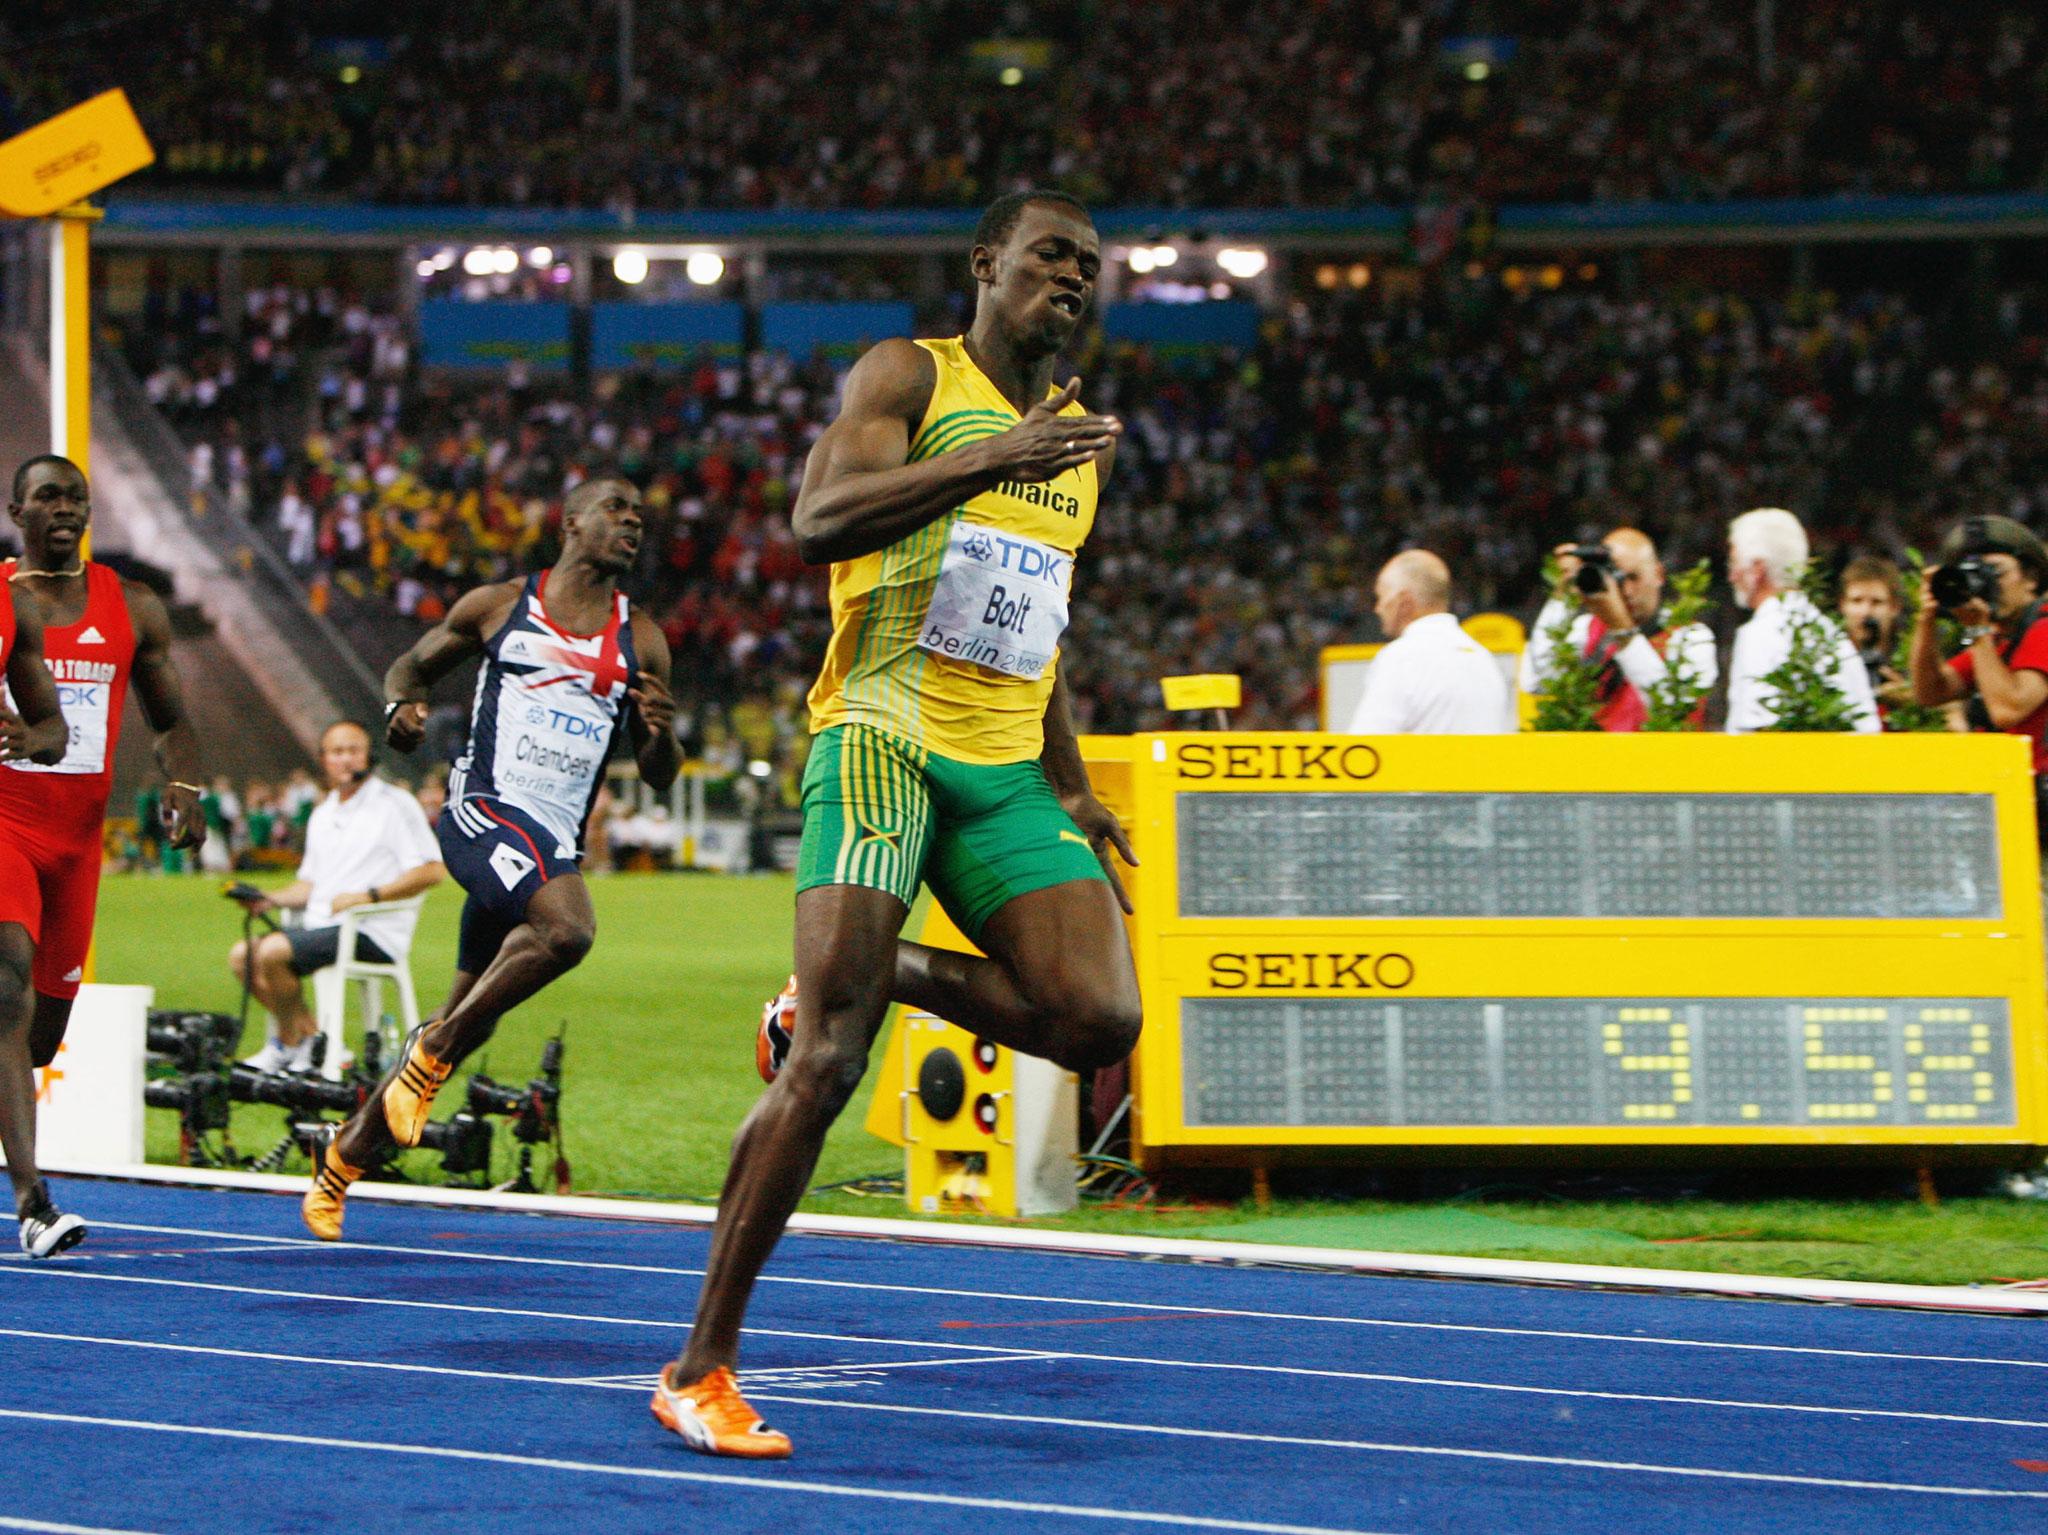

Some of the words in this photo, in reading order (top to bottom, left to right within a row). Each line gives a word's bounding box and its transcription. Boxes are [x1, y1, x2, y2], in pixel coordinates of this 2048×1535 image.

[995, 537, 1065, 587] TDK
[982, 584, 1032, 635] Bolt
[925, 625, 999, 664] berlin
[56, 687, 97, 706] DK
[548, 709, 607, 742] TDK
[515, 734, 592, 779] Chambers
[1176, 744, 1382, 780] SEIKO
[1208, 953, 1415, 989] SEIKO
[1603, 1008, 1993, 1119] 9.58
